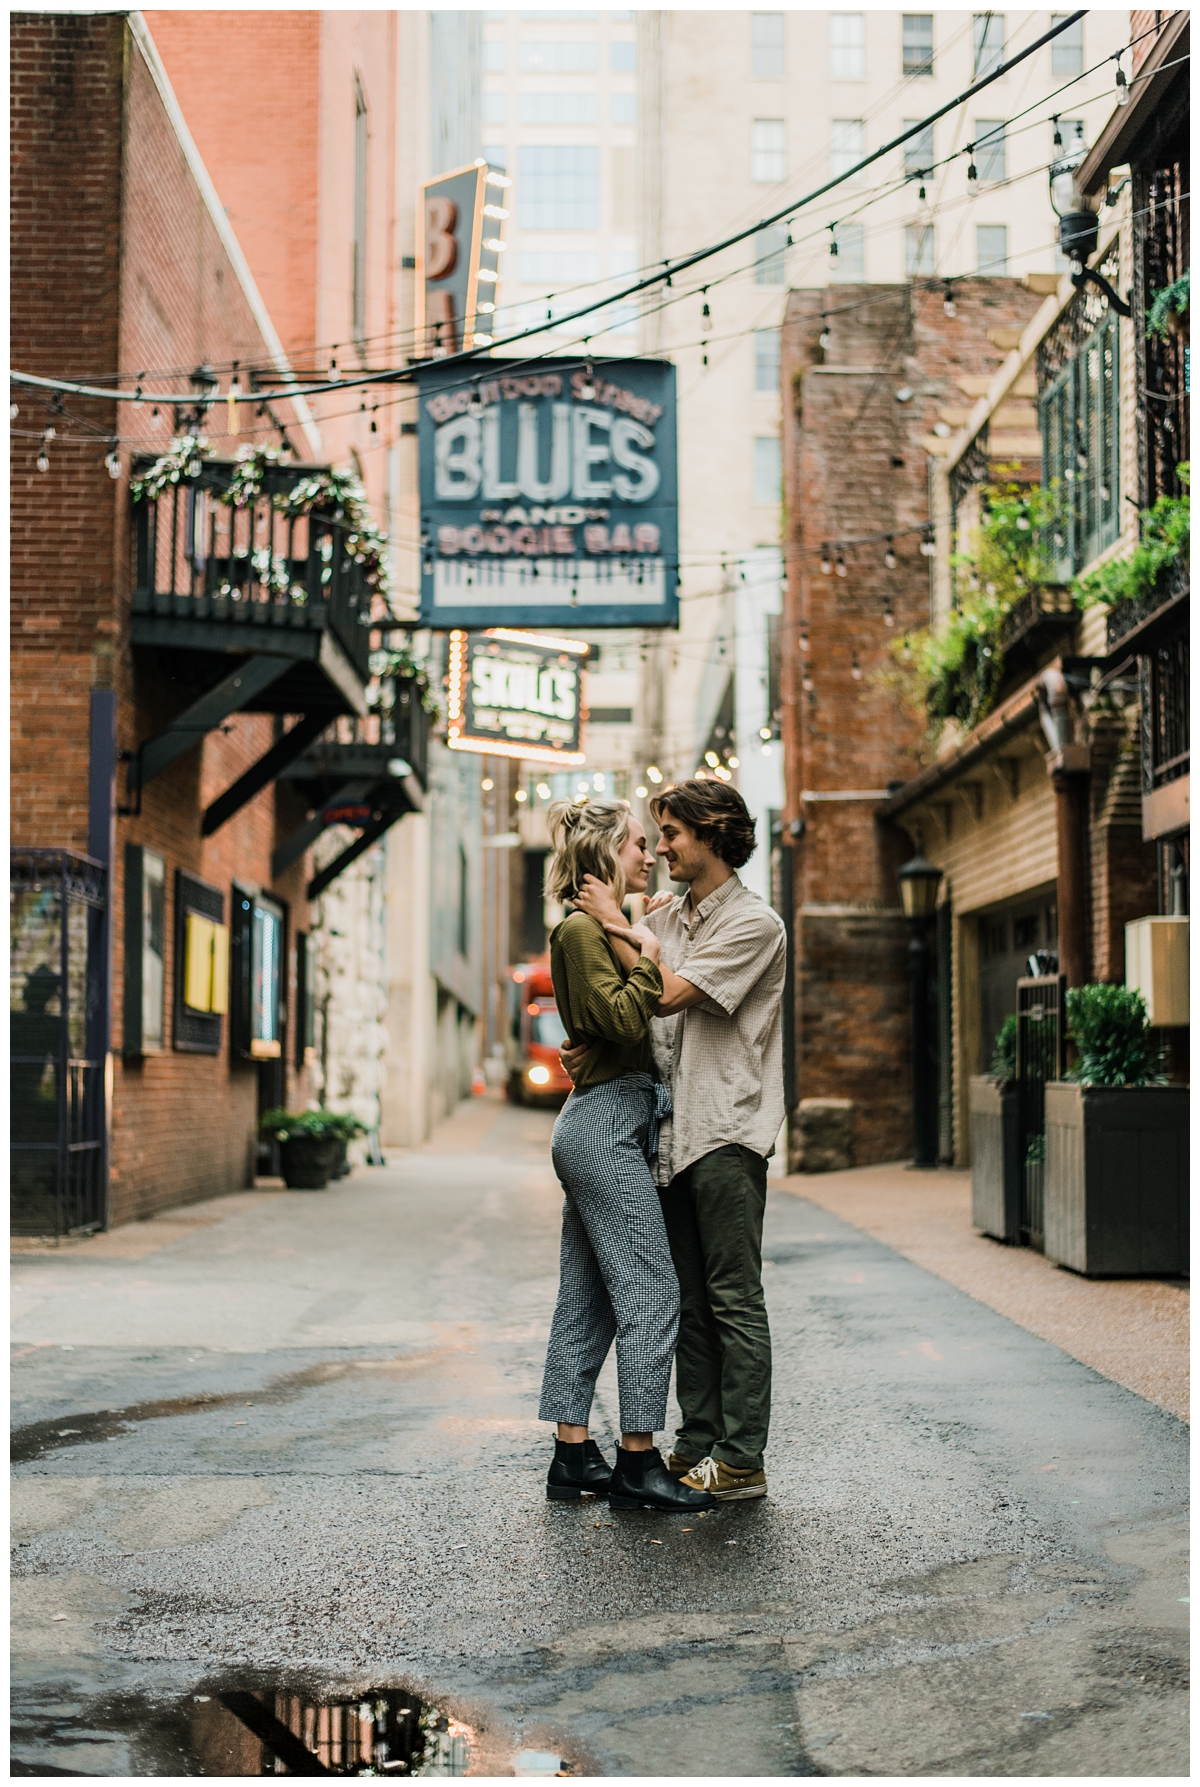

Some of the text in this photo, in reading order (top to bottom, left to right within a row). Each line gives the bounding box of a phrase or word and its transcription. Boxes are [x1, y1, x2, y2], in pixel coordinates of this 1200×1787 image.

[433, 401, 661, 503] BLUES
[503, 505, 588, 526] AND
[436, 522, 661, 556] BOOGIE BAR
